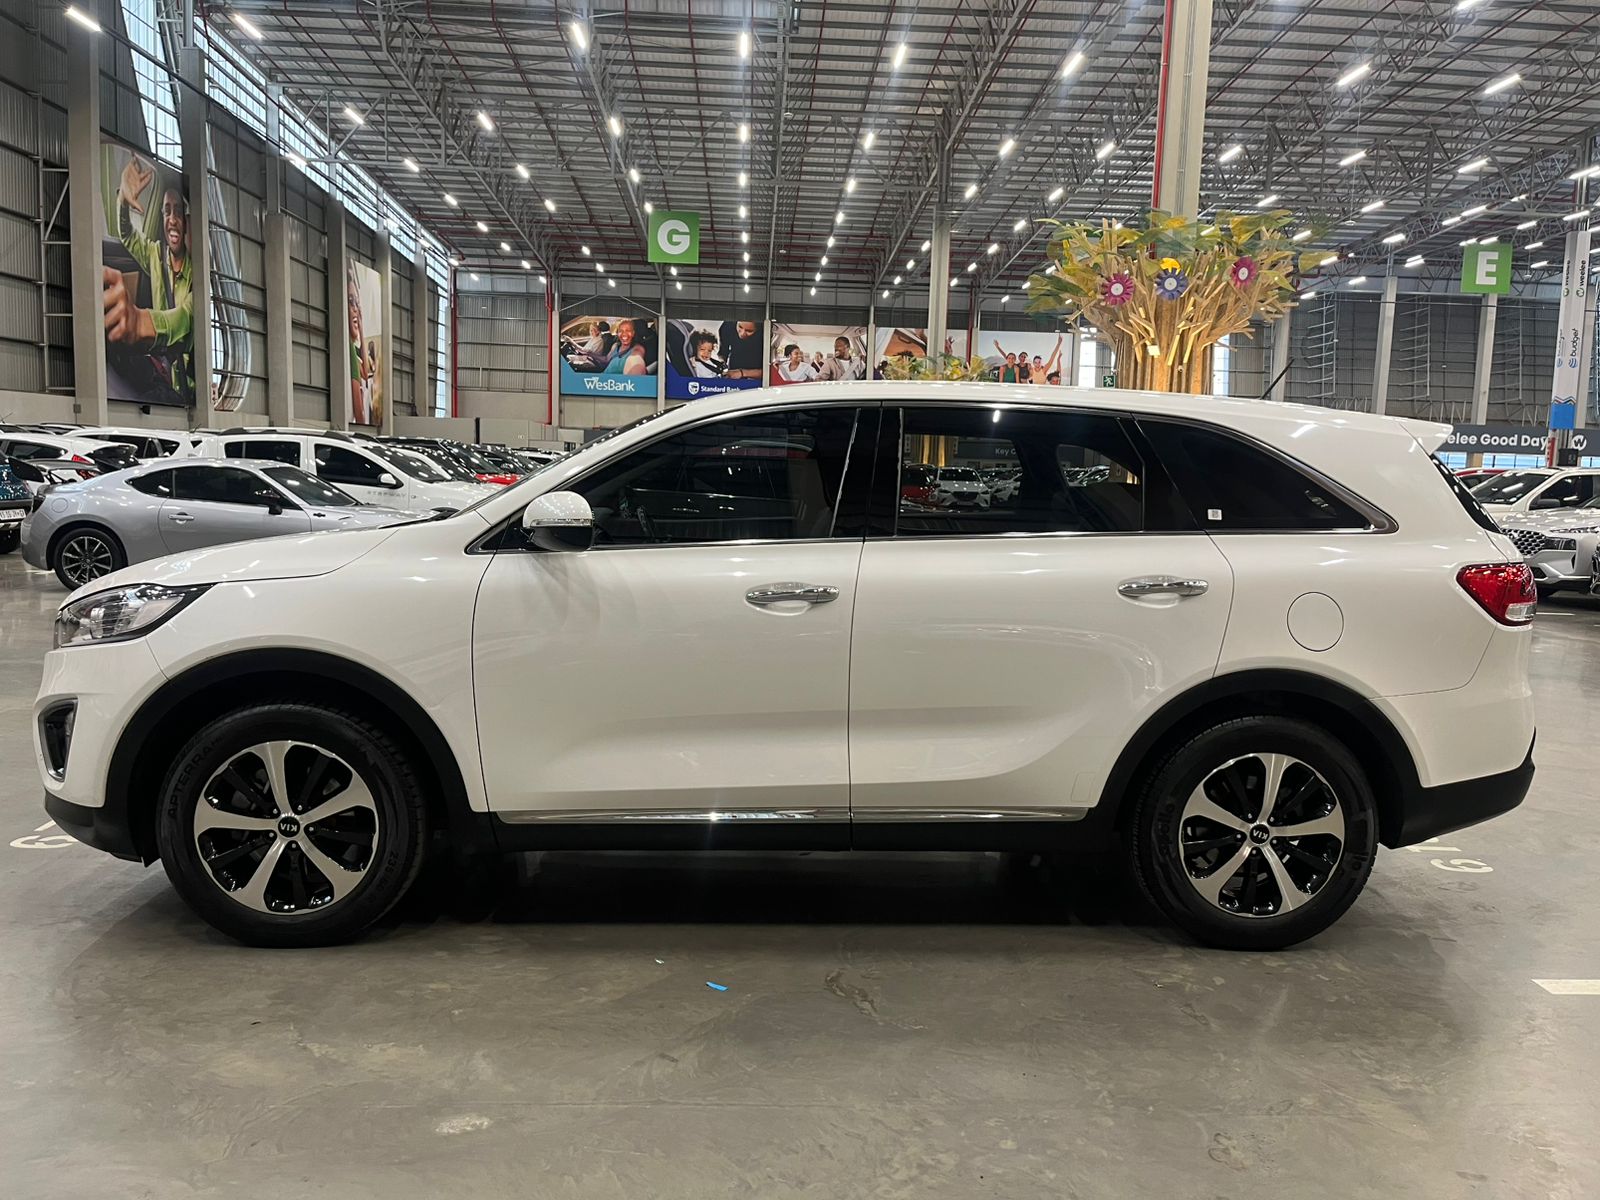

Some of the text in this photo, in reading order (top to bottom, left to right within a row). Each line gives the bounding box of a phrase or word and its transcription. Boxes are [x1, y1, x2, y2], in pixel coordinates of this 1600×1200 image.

[657, 220, 691, 255] G
[1476, 251, 1499, 285] E
[1578, 260, 1586, 286] weelee
[1570, 328, 1581, 357] budget
[584, 376, 635, 392] WesBank
[1480, 433, 1518, 446] Good
[1520, 435, 1548, 450] Day
[280, 822, 298, 832] KIA
[1253, 829, 1268, 840] KIA
